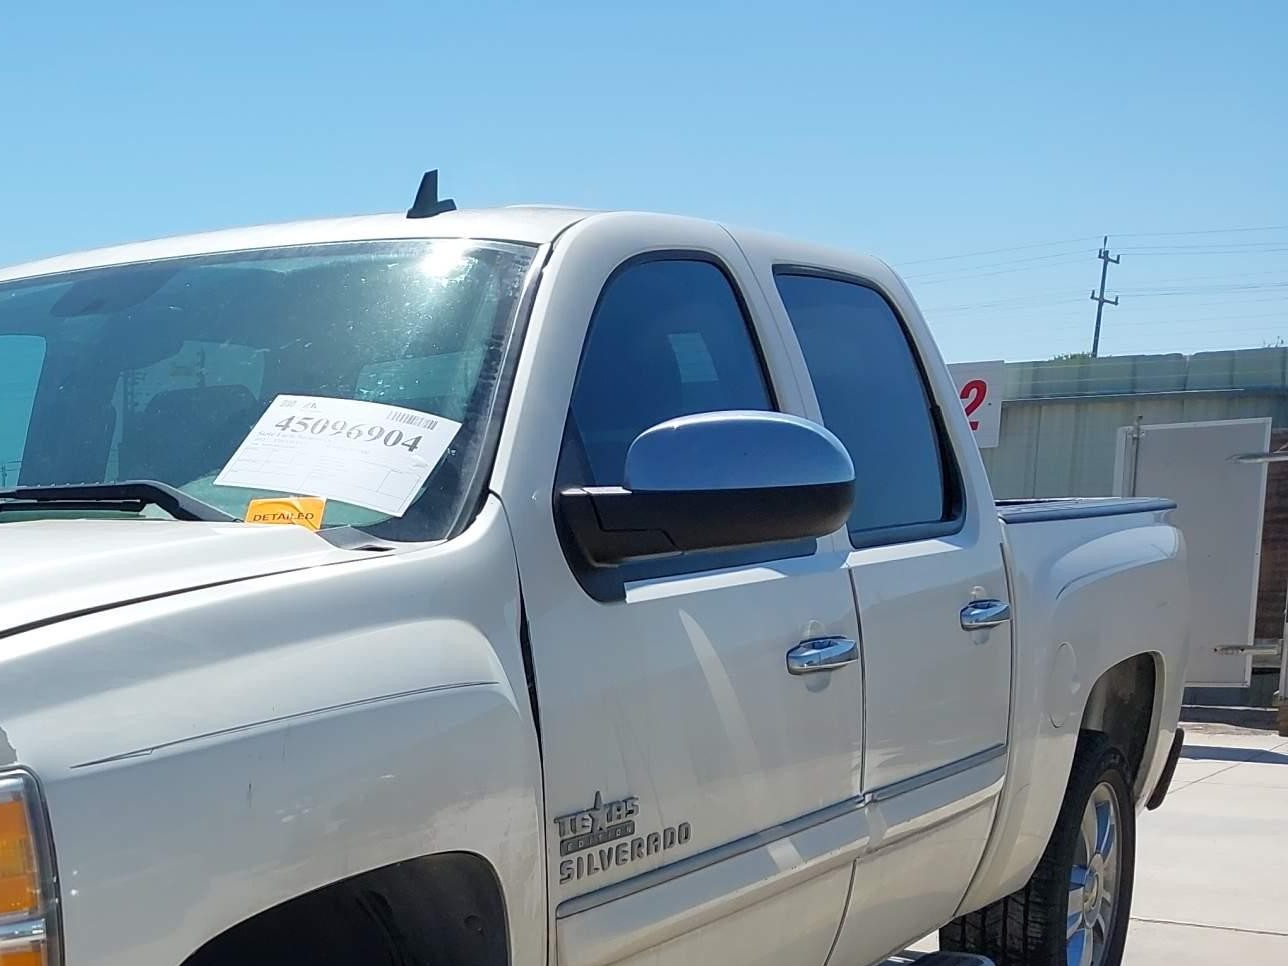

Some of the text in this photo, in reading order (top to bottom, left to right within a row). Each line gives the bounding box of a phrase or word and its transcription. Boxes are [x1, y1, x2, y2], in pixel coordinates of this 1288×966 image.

[960, 379, 987, 431] 2
[275, 415, 423, 452] 45096904
[253, 512, 315, 522] DETAILED
[554, 790, 639, 837] TEXAS
[559, 822, 692, 885] SILVERADO
[566, 825, 635, 851] EDITION
